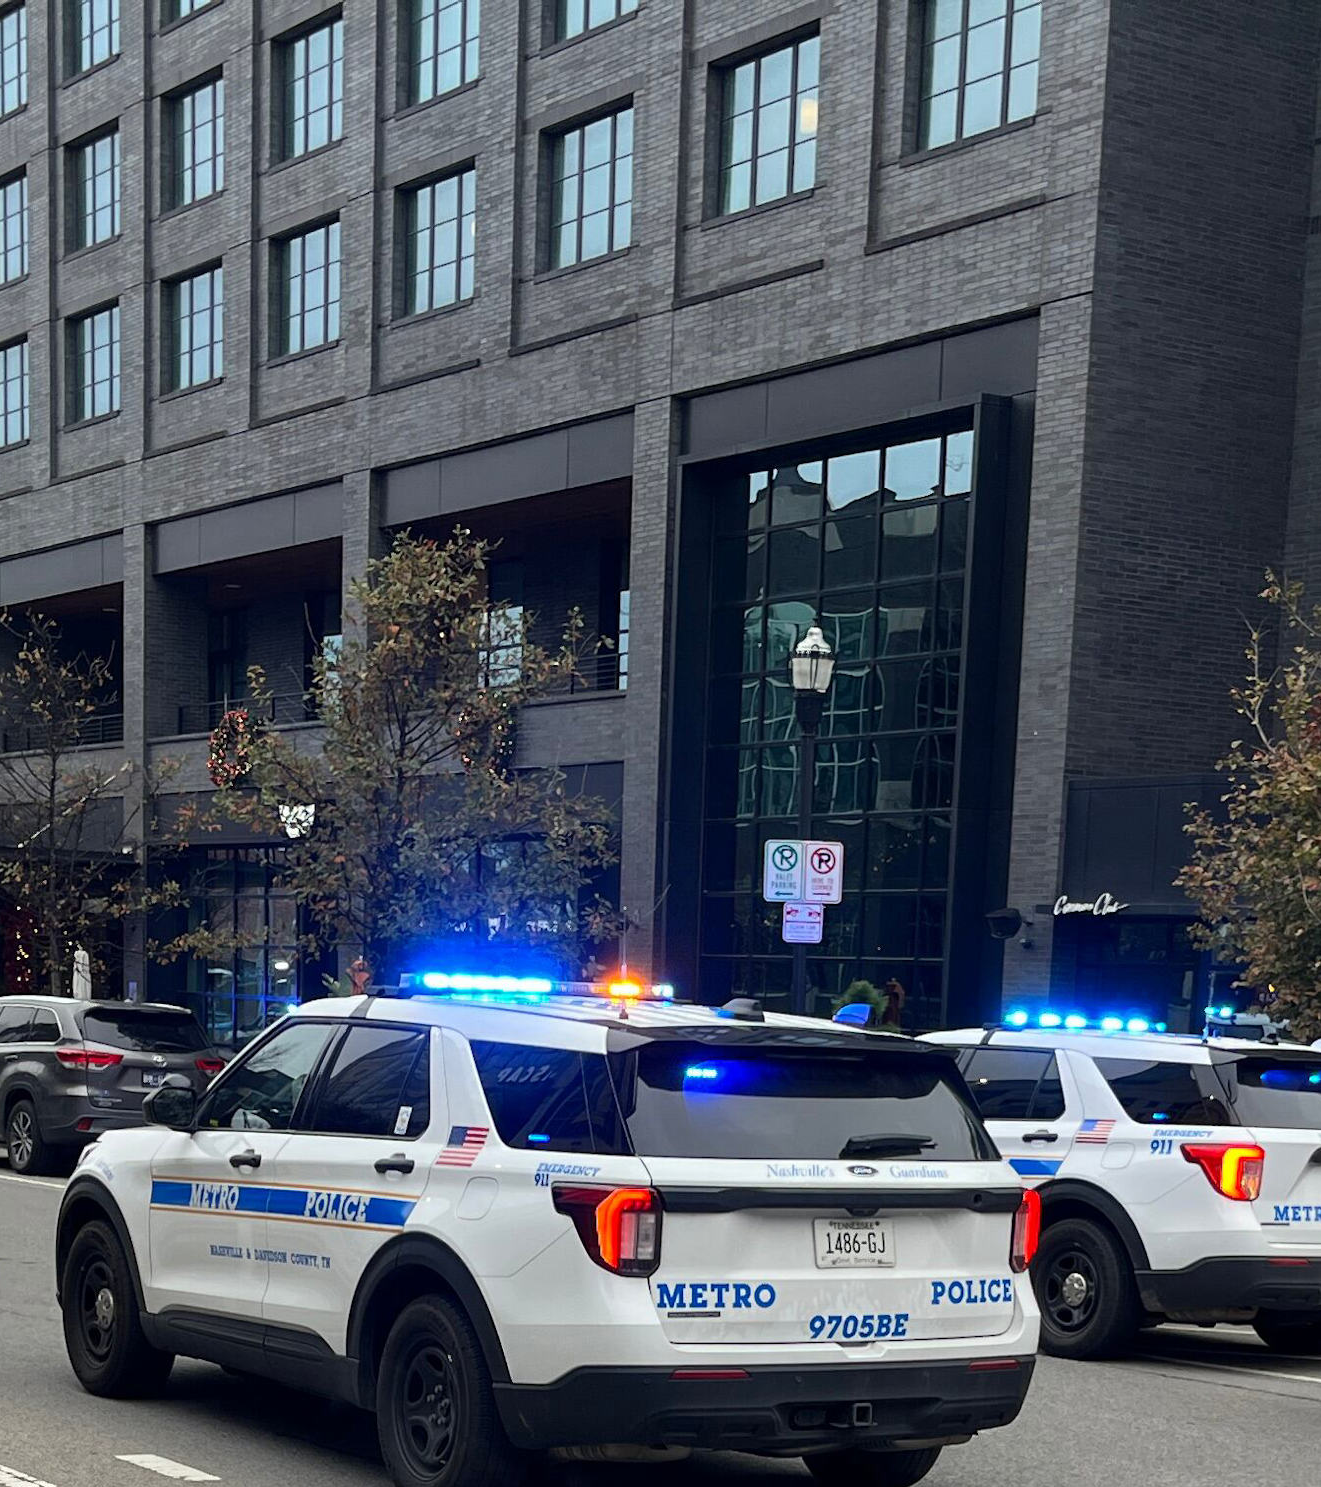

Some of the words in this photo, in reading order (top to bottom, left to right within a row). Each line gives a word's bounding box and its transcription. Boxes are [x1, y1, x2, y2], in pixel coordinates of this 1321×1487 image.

[1150, 1139, 1173, 1155] 911
[536, 1163, 601, 1177] EMERGENCY
[766, 1164, 835, 1178] Nashville's
[889, 1165, 949, 1179] Guardians
[534, 1174, 549, 1187] 911
[189, 1183, 239, 1211] METRO
[303, 1191, 371, 1223] POLICE
[833, 1221, 875, 1230] TENNESSEE
[826, 1232, 886, 1254] 1486-GJ
[210, 1245, 243, 1259] NASHVILLE
[254, 1249, 288, 1264] DAVIDSON
[291, 1254, 320, 1270] COUNTY,
[321, 1256, 331, 1269] TN
[657, 1283, 776, 1308] METRO
[931, 1279, 1012, 1304] POLICE
[809, 1313, 909, 1339] 9705BE
